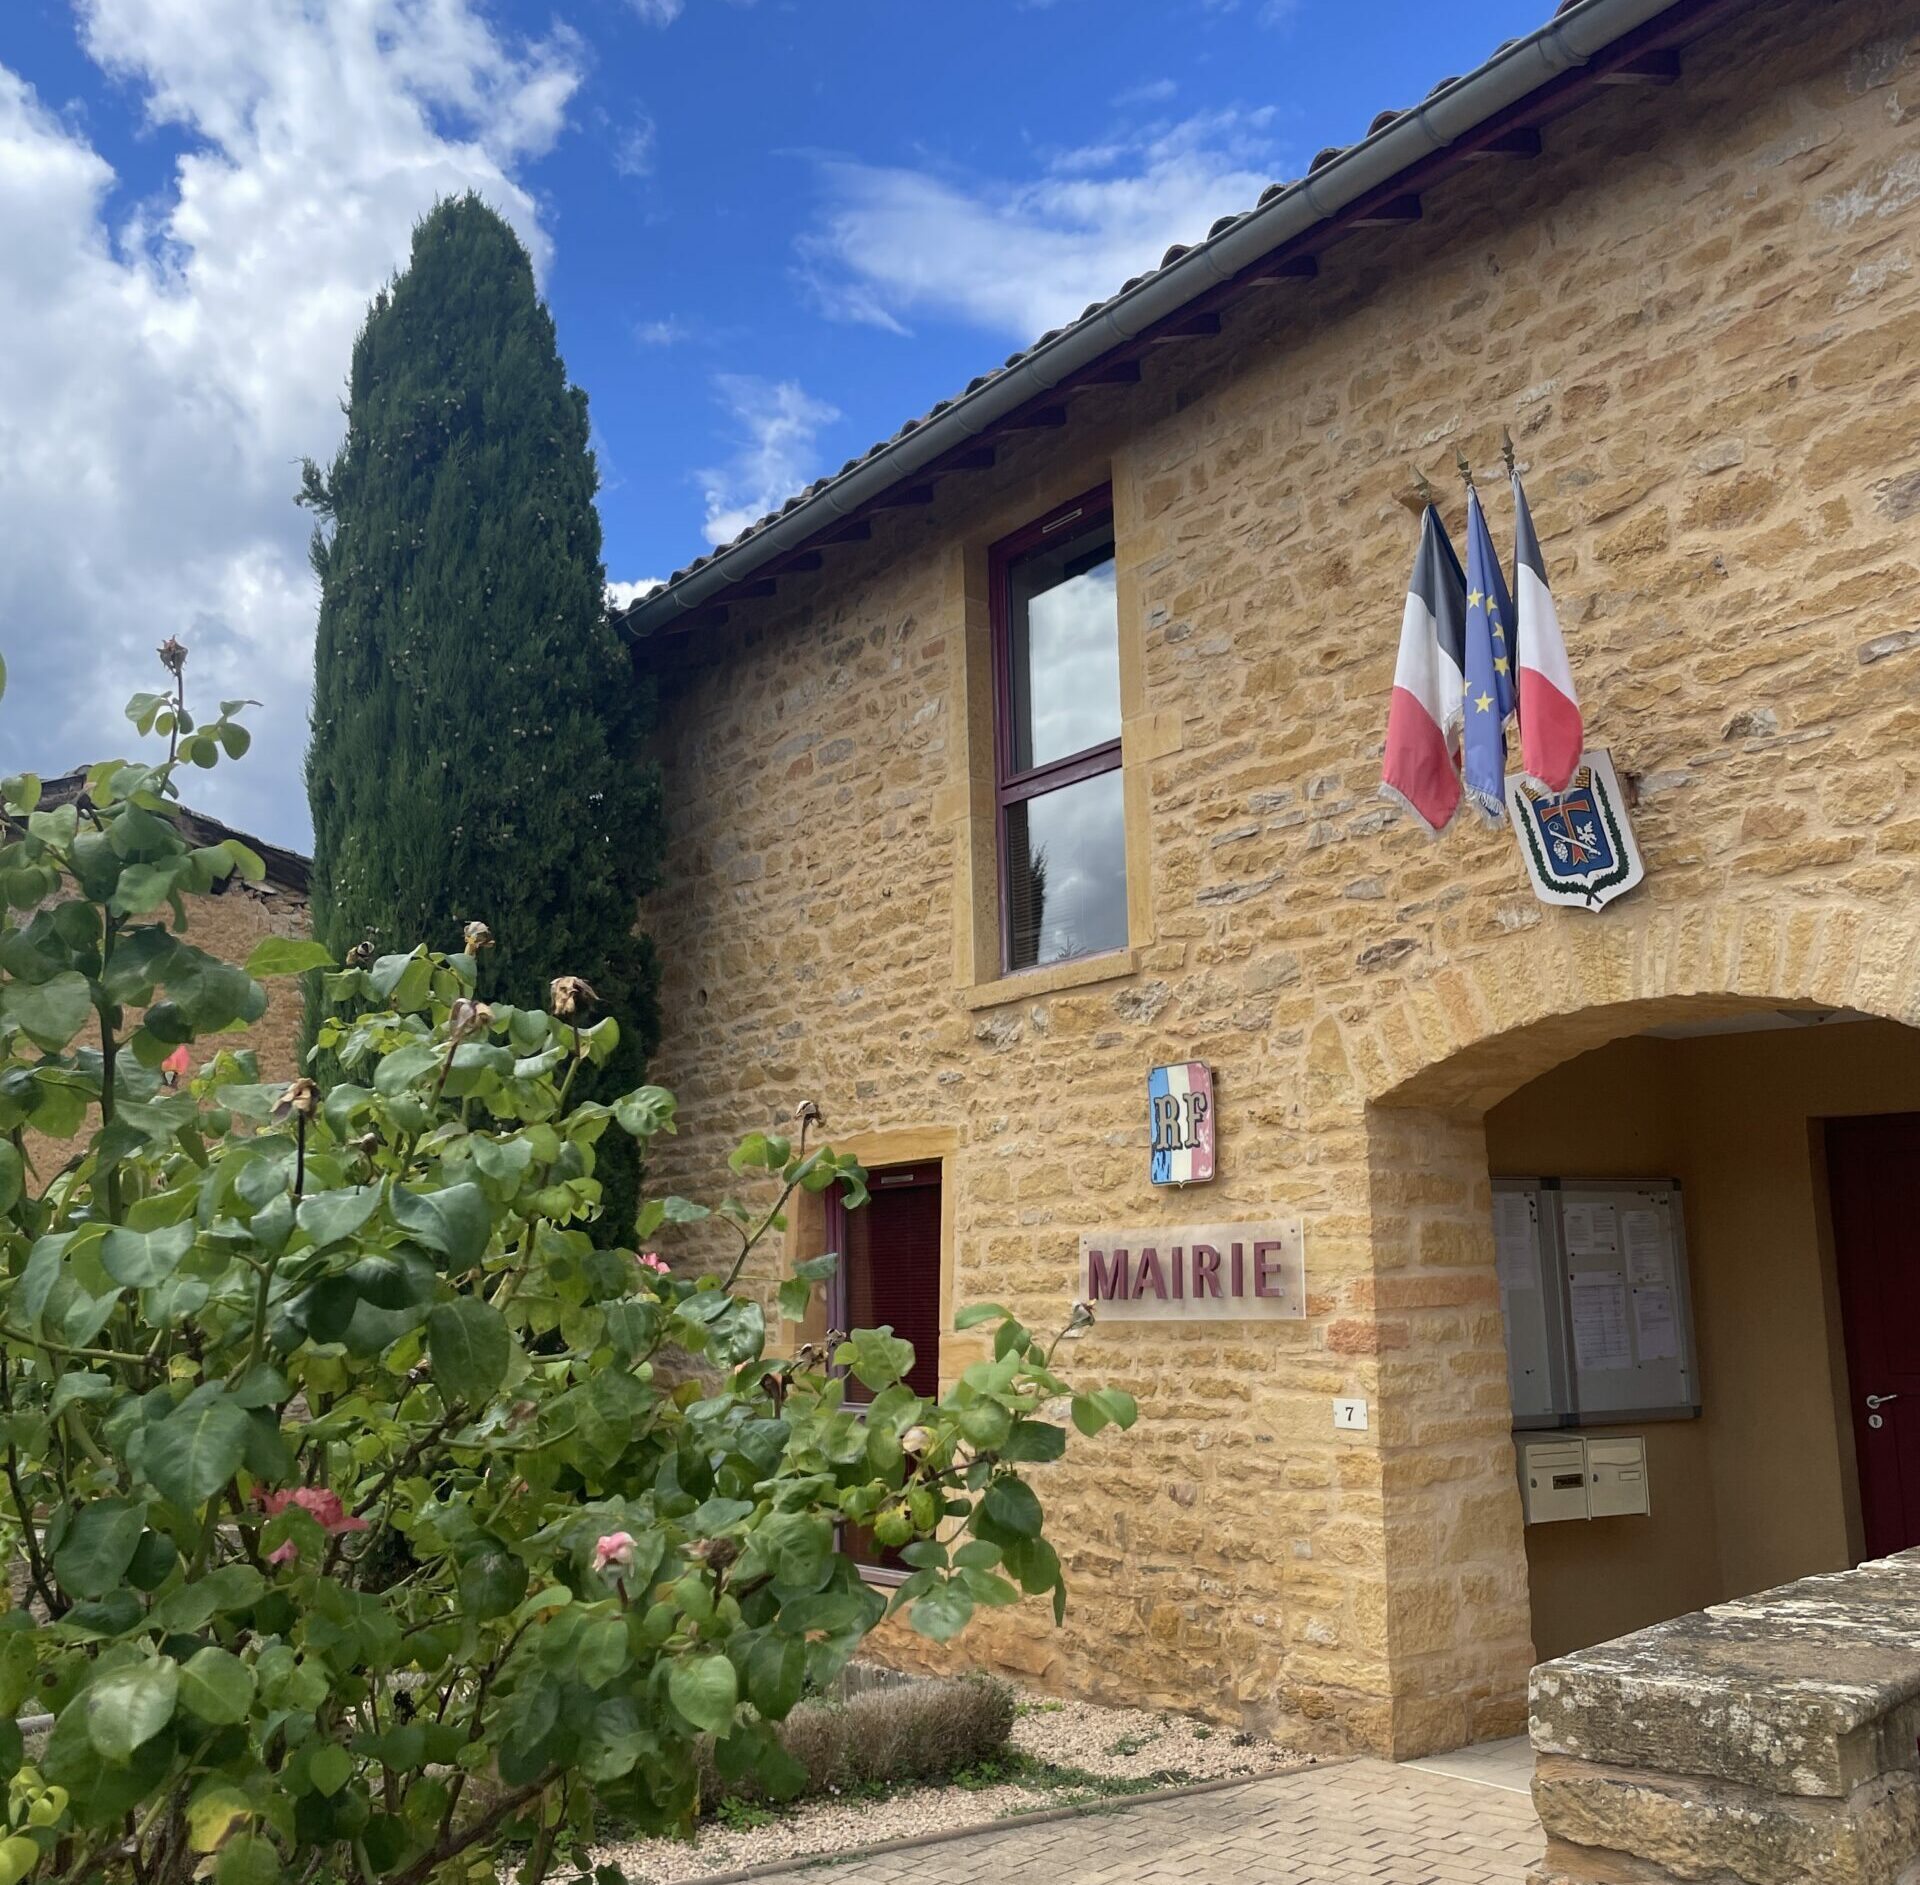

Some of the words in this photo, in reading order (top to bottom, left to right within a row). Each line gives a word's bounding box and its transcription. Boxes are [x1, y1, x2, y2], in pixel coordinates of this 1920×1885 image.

[1154, 1092, 1207, 1151] RF
[1088, 1241, 1284, 1300] MAIRIE
[1345, 1406, 1354, 1421] 7
